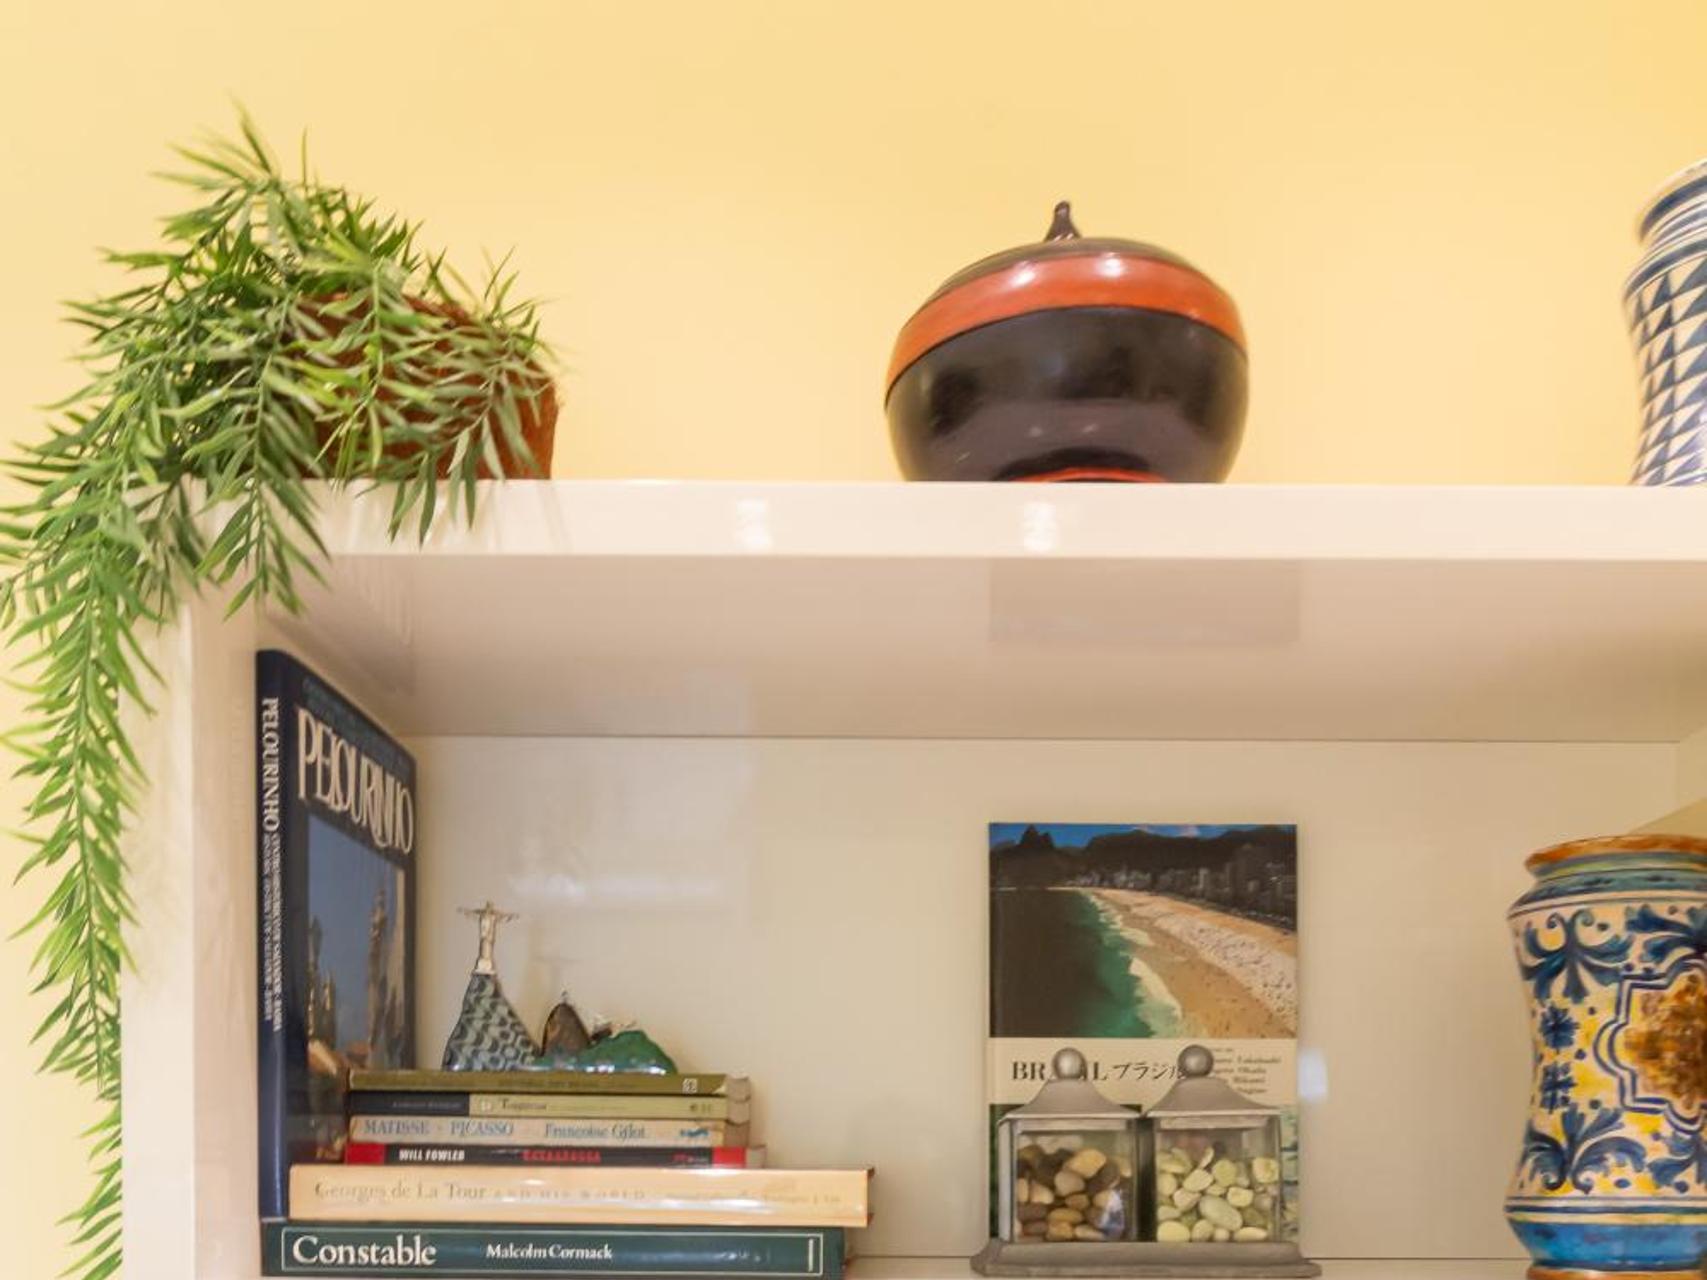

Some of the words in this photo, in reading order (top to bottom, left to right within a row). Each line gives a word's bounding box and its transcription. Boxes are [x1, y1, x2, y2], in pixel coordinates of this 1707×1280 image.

[262, 697, 280, 832] PELOURINHO
[364, 1119, 430, 1136] MATISSE
[450, 1121, 514, 1137] PICASSO
[398, 1149, 422, 1161] WILL
[425, 1150, 466, 1161] FOWLER
[315, 1181, 387, 1206] Georges
[392, 1179, 411, 1199] de
[417, 1181, 438, 1199] La
[446, 1180, 487, 1200] Tour
[292, 1234, 437, 1266] Constable
[486, 1242, 547, 1259] Malcolm
[548, 1243, 613, 1260] Cormack
